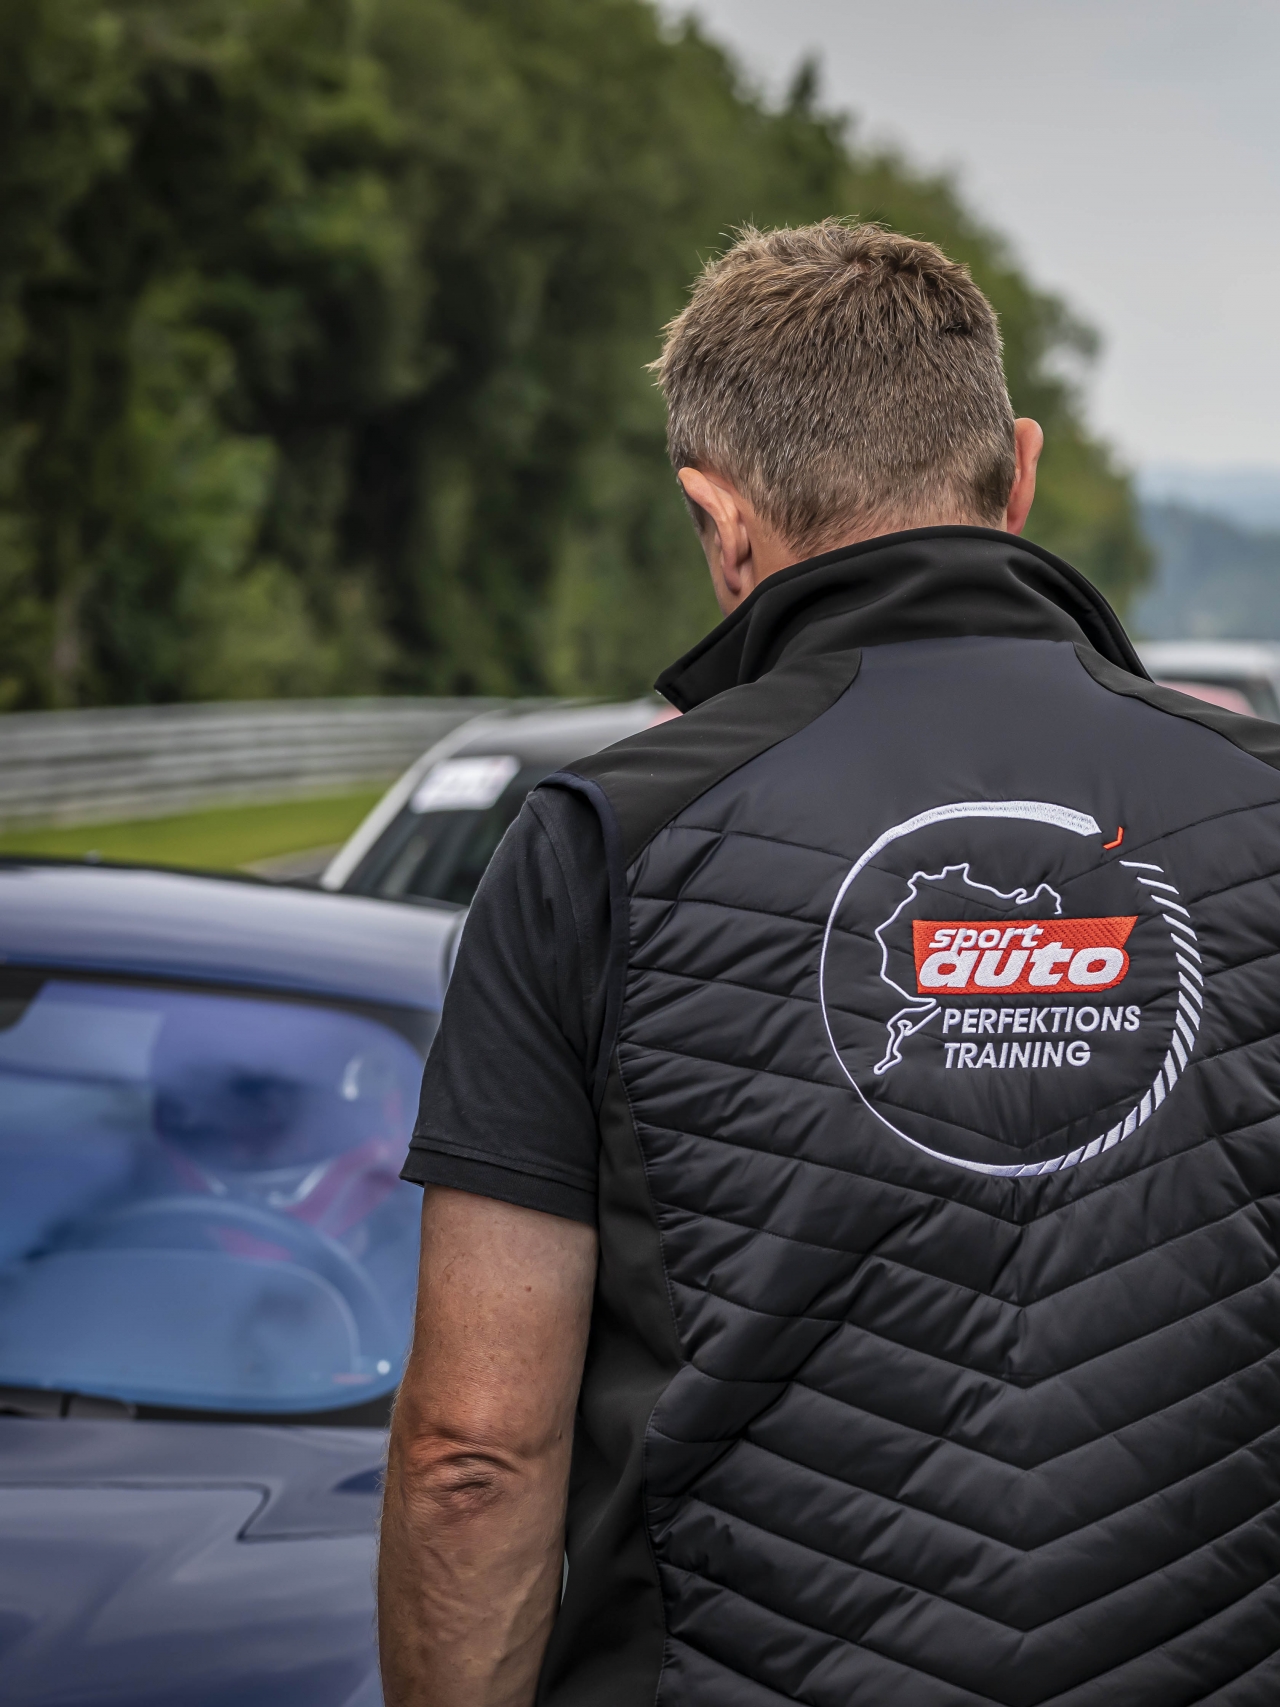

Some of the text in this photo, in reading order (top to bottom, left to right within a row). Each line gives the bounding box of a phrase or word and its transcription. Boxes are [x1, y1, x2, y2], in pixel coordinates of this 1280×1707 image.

[929, 923, 1044, 955] sport
[919, 942, 1125, 988] auto
[942, 1005, 1142, 1035] PERFEKTIONS
[944, 1041, 1092, 1069] TRAINING
